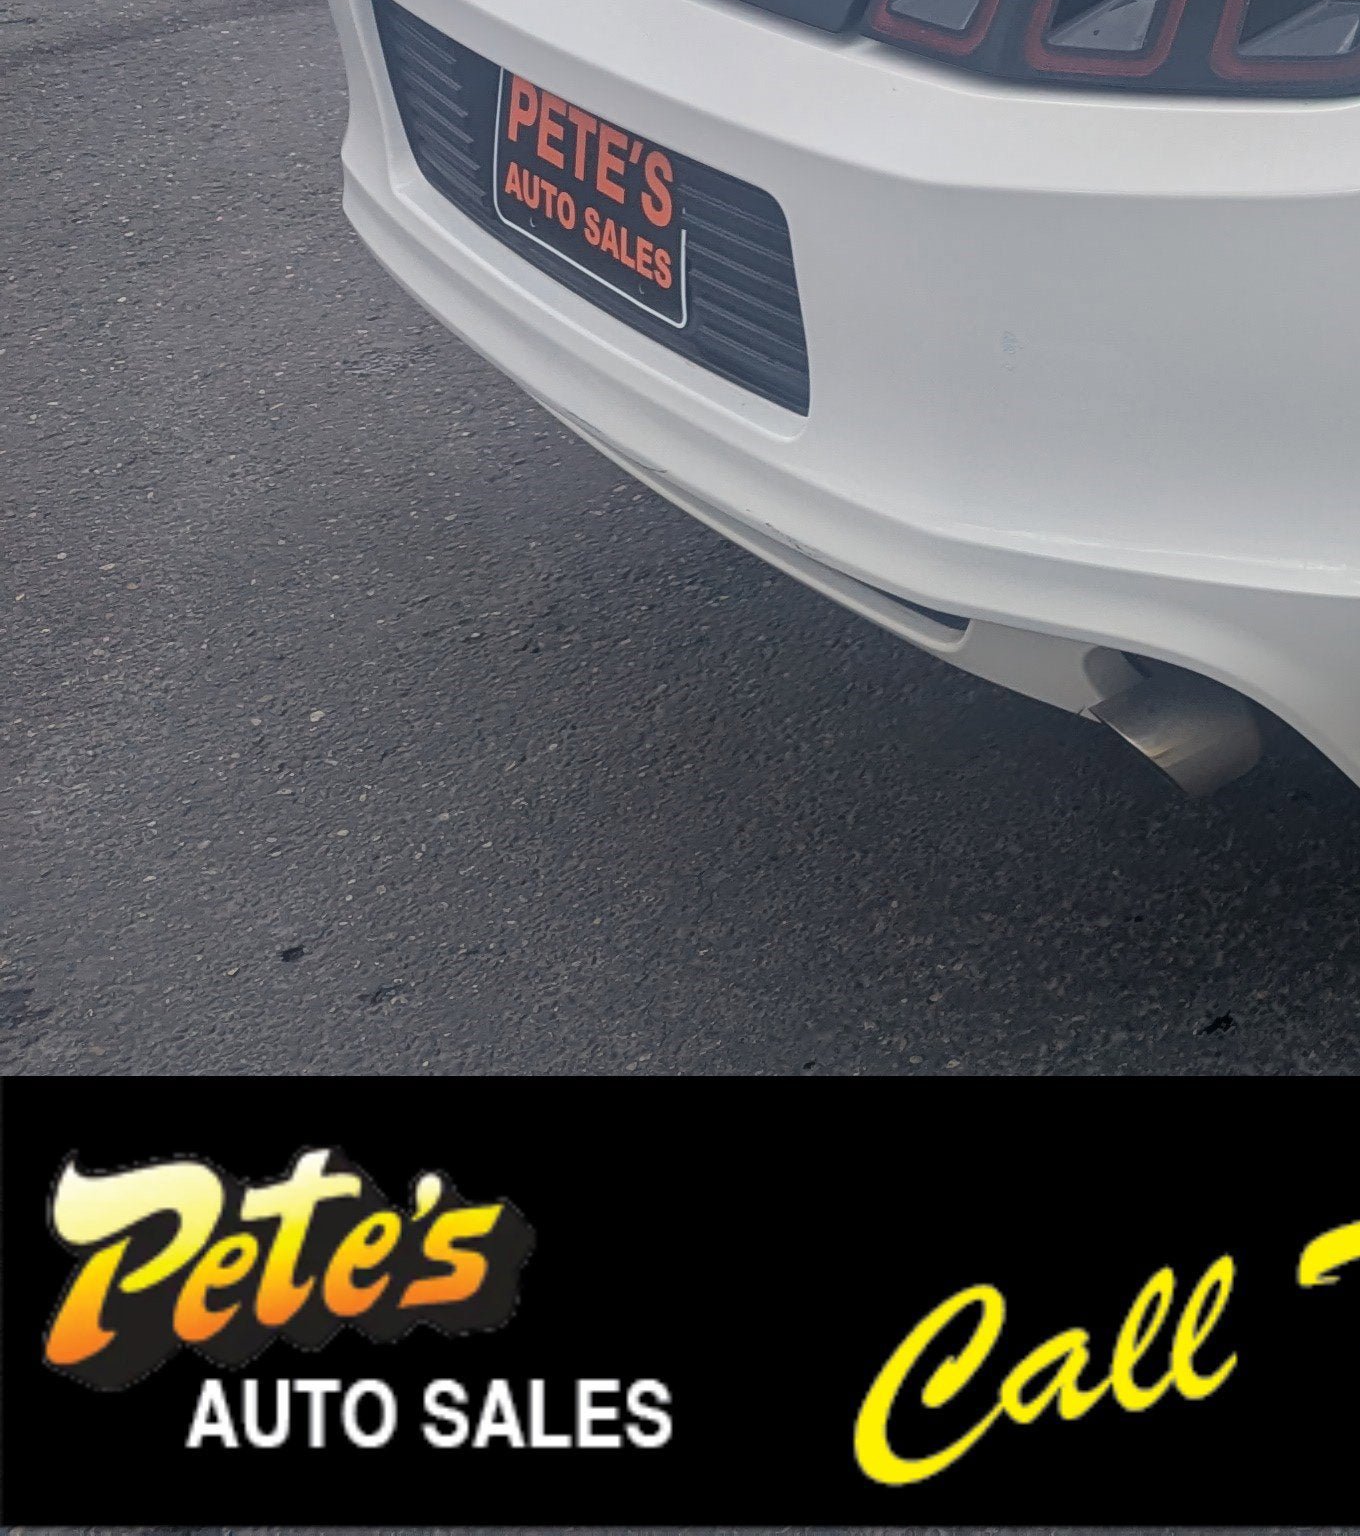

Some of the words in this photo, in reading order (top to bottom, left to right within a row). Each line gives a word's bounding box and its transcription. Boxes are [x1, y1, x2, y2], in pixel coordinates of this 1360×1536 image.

[507, 74, 674, 227] PETE'S
[504, 161, 576, 230] AUTO
[584, 207, 673, 289] SALES
